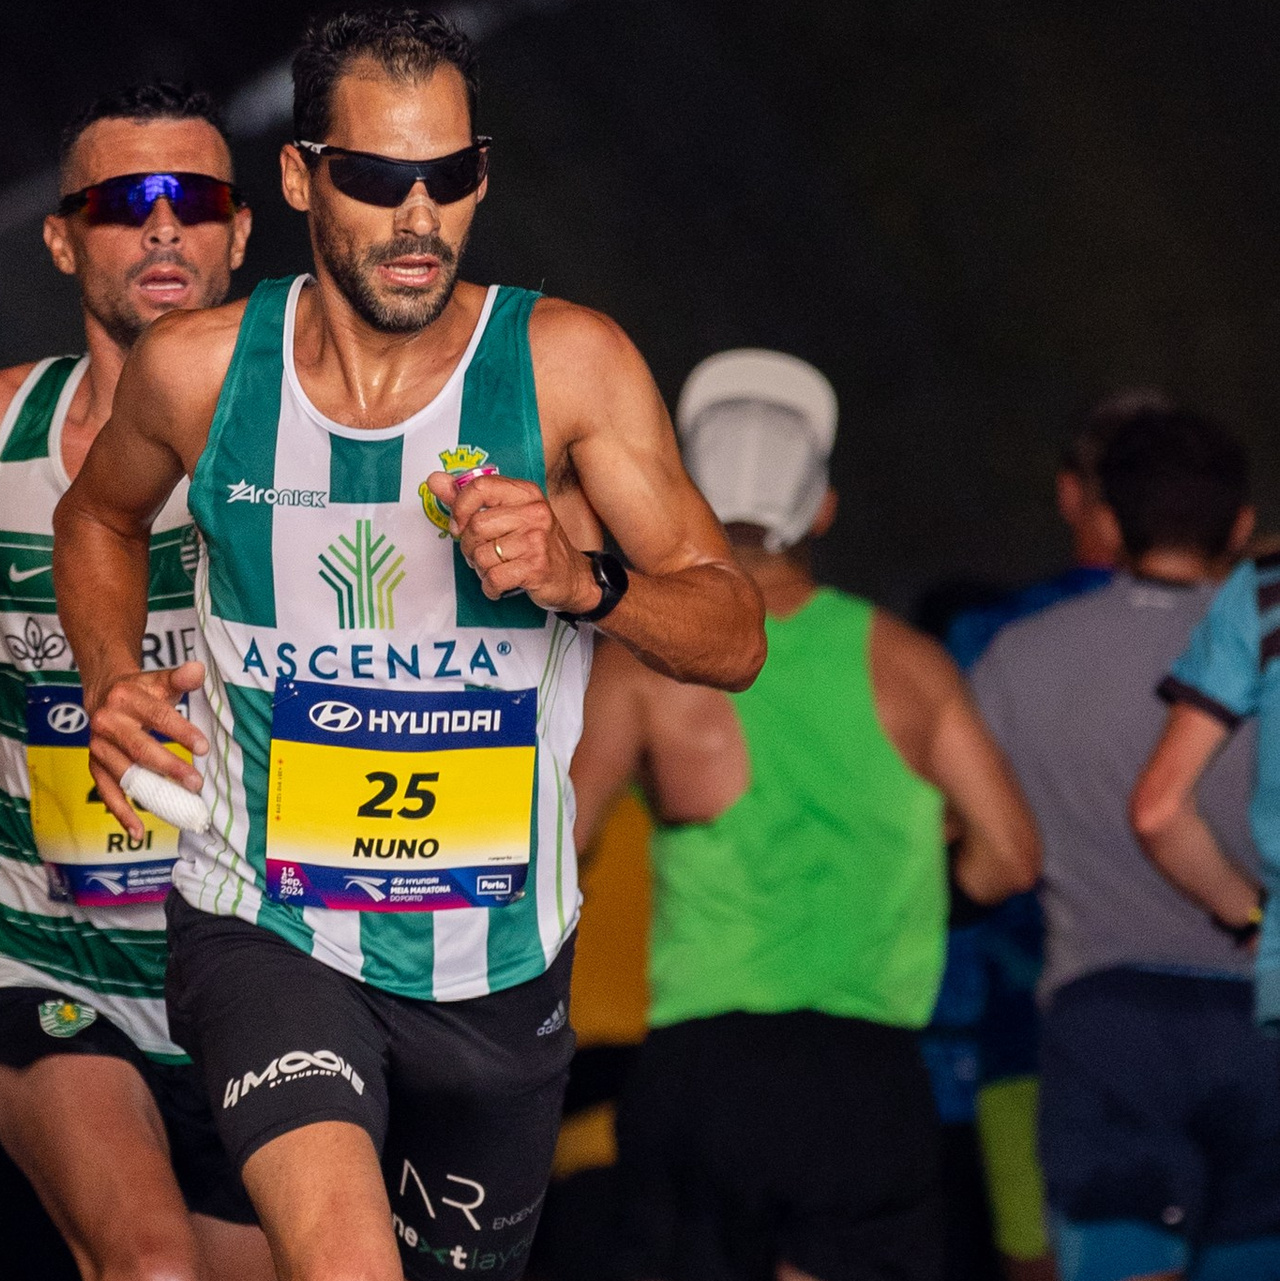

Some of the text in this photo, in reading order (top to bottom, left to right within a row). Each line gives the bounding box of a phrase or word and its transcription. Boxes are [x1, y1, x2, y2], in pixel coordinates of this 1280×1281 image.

[369, 709, 501, 735] HYUNDAI
[358, 771, 440, 820] 25
[106, 830, 154, 854] RUI
[352, 837, 440, 859] NUNO
[281, 866, 295, 877] 15
[281, 885, 304, 897] 2024
[390, 884, 451, 895] MEIA MARATONA
